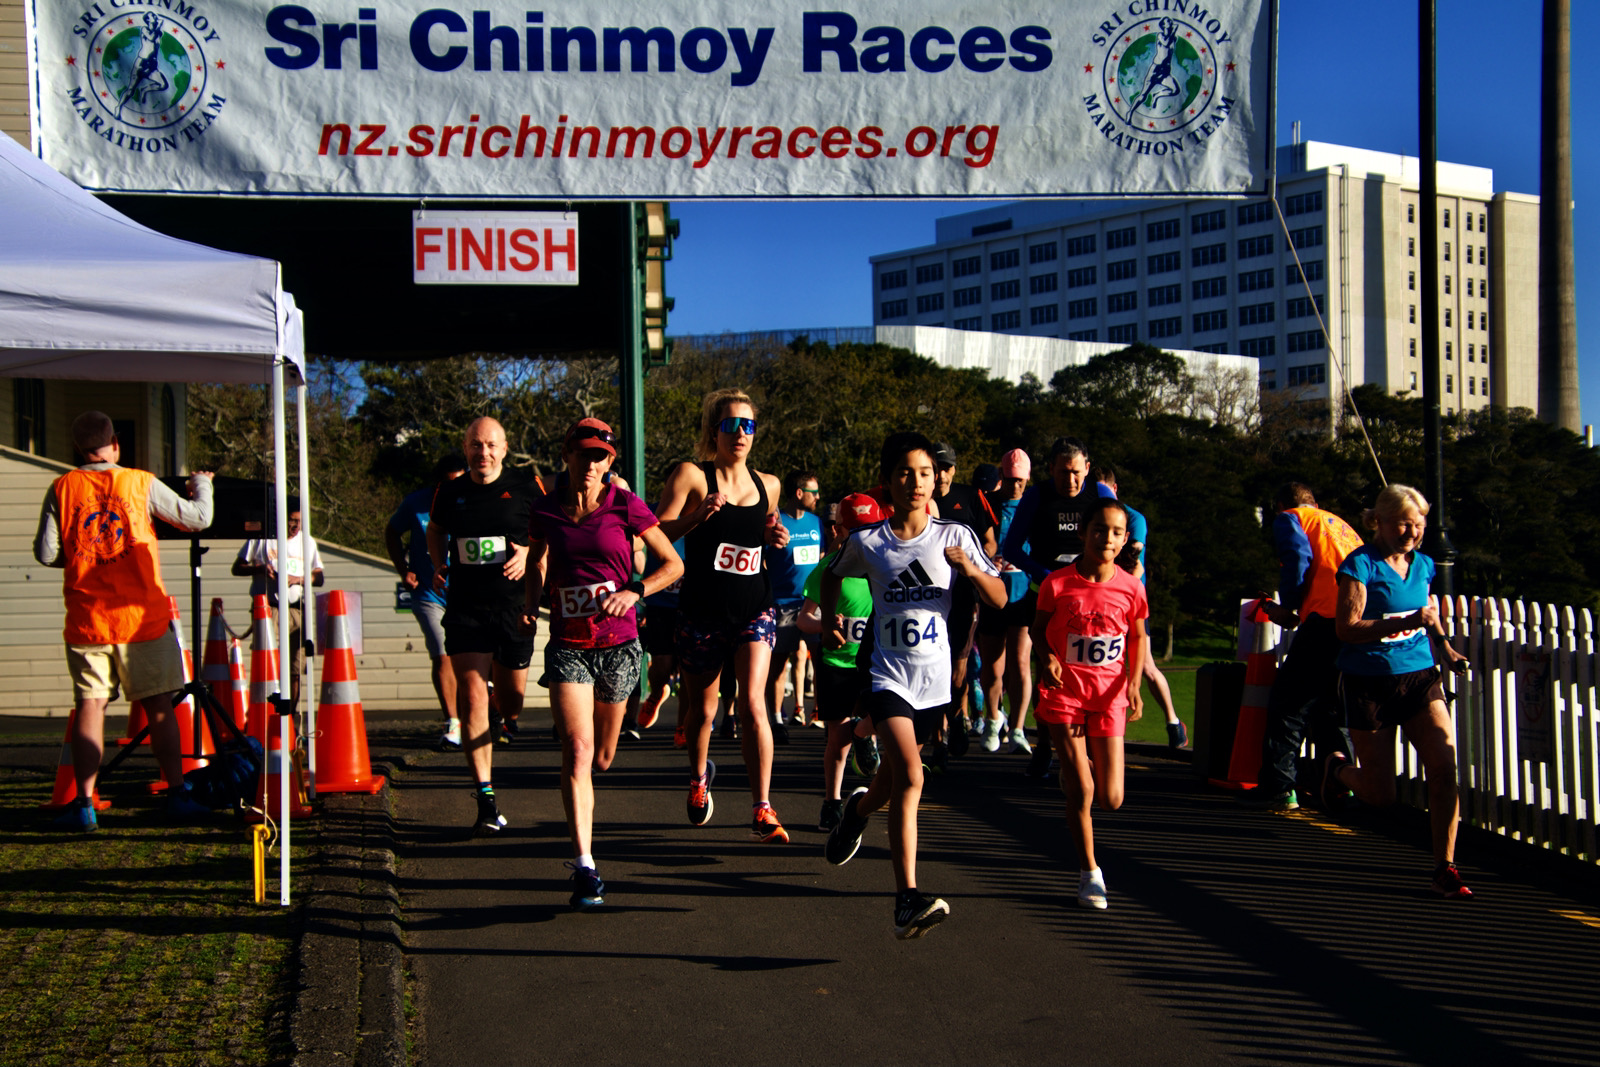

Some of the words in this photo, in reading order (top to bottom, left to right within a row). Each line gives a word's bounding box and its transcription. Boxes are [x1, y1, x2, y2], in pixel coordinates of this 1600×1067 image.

[73, 3, 106, 38] SRI
[1092, 12, 1124, 47] SRI
[1128, 0, 1232, 46] CHINMOY
[264, 4, 379, 70] Sri
[409, 8, 775, 87] Chinmoy
[803, 11, 1054, 73] Races
[67, 86, 178, 153] MARATHON
[180, 93, 227, 143] TEAM
[1083, 93, 1184, 156] MARATHON
[1187, 95, 1236, 145] TEAM
[317, 114, 1000, 169] nz.srichinmoyraces.org
[415, 227, 577, 272] FINISH
[465, 540, 496, 562] 98
[719, 546, 759, 572] 560
[800, 548, 817, 563] 93
[884, 586, 943, 603] adidas
[884, 616, 939, 647] 164
[1072, 638, 1121, 664] 165
